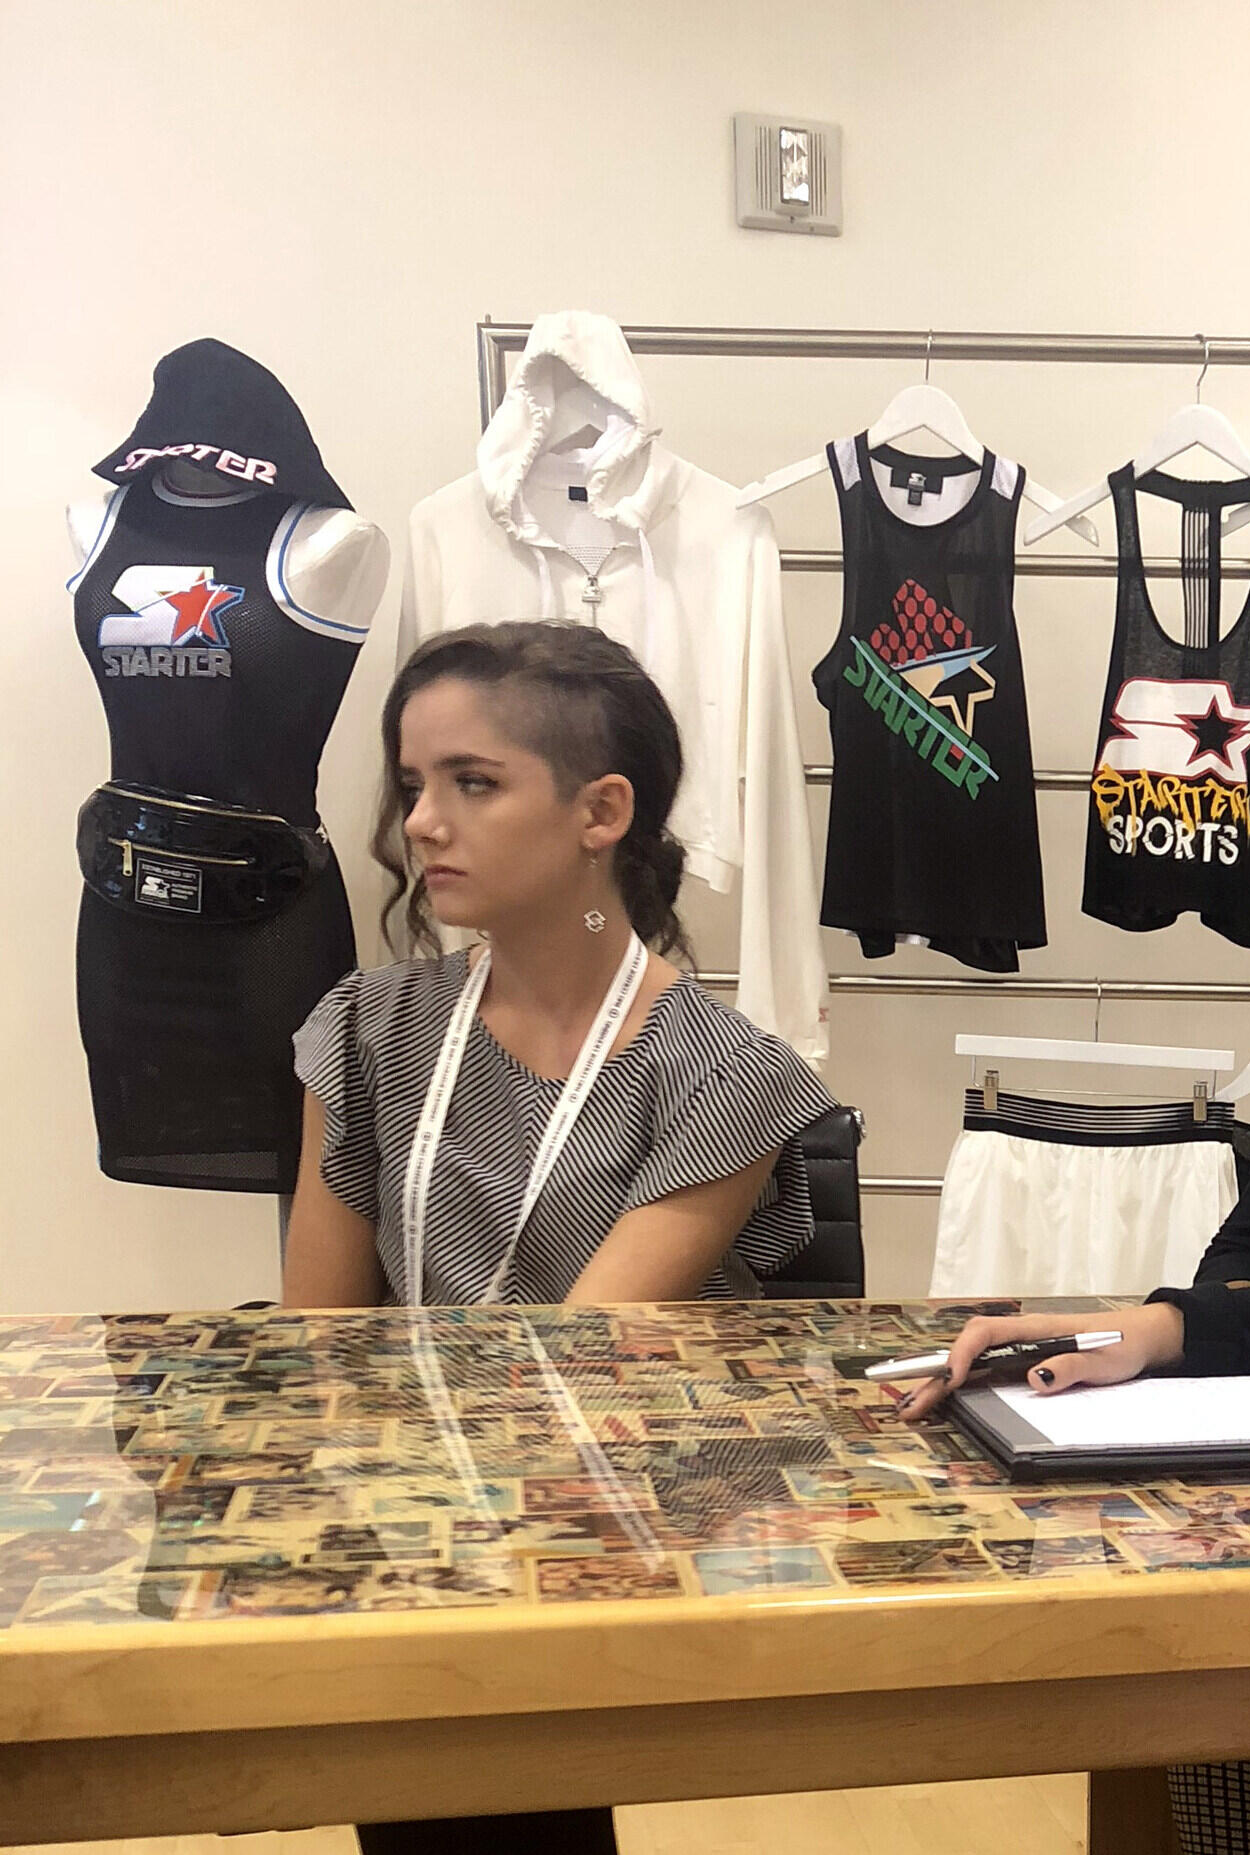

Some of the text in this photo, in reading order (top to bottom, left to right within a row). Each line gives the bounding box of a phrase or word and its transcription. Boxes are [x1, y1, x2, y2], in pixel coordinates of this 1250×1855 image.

[102, 646, 231, 677] STARTER
[843, 640, 991, 800] STARTER
[1107, 814, 1239, 865] SPORTS
